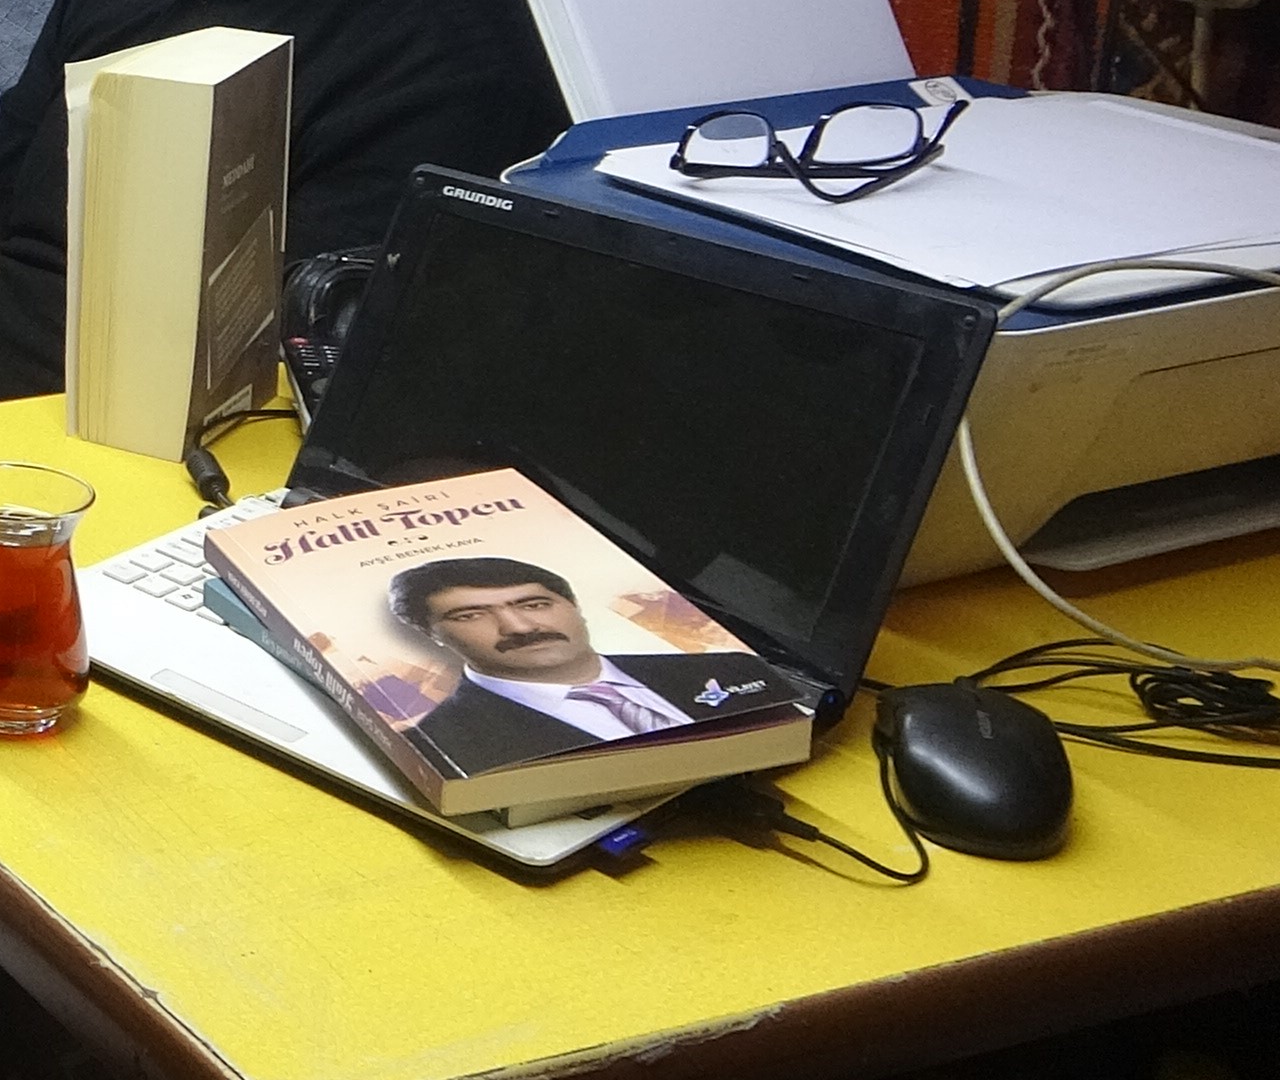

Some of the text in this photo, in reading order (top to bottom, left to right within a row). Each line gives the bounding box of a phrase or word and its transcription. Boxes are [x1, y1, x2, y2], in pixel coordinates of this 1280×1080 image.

[442, 185, 513, 211] GRUNDIG
[264, 496, 525, 565] Halil Topcu
[294, 508, 363, 528] HALK
[359, 536, 485, 569] AYŞE BENEK KAYA
